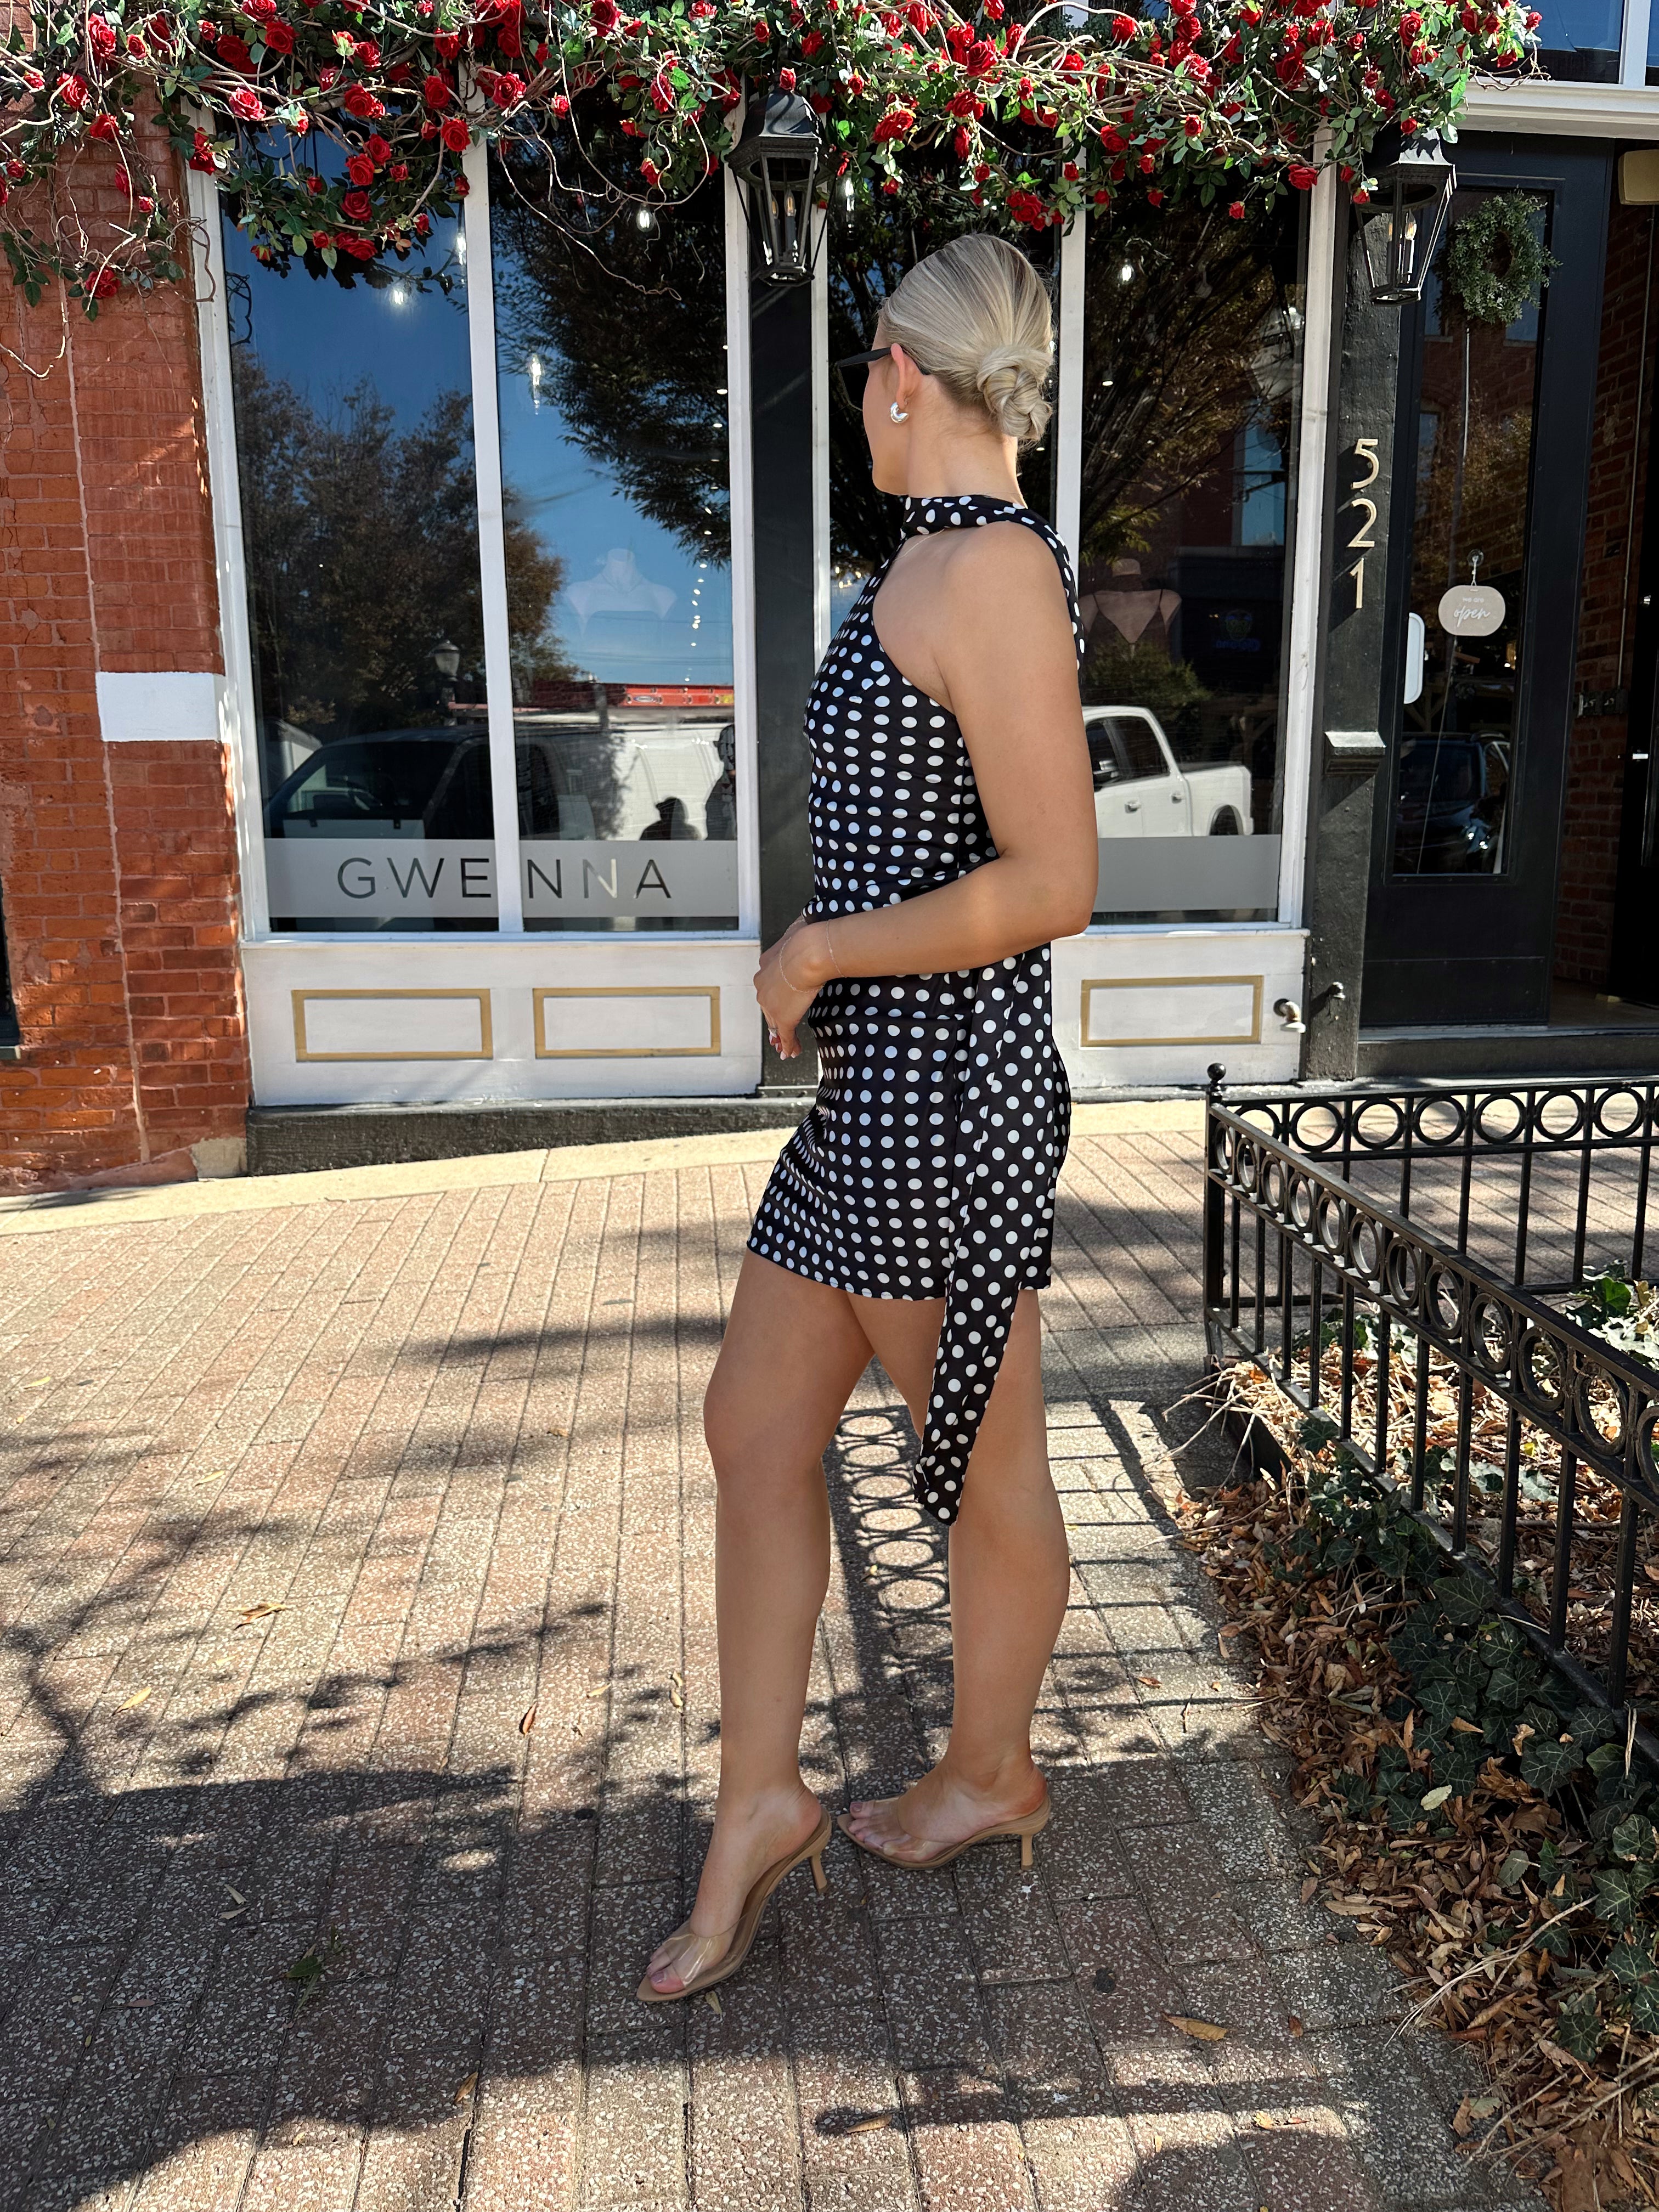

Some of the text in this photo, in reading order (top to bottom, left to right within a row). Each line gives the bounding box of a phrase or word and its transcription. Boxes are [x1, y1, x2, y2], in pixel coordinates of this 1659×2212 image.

[1346, 438, 1380, 610] 521
[1453, 605, 1492, 628] open
[337, 857, 672, 900] GWENNA
